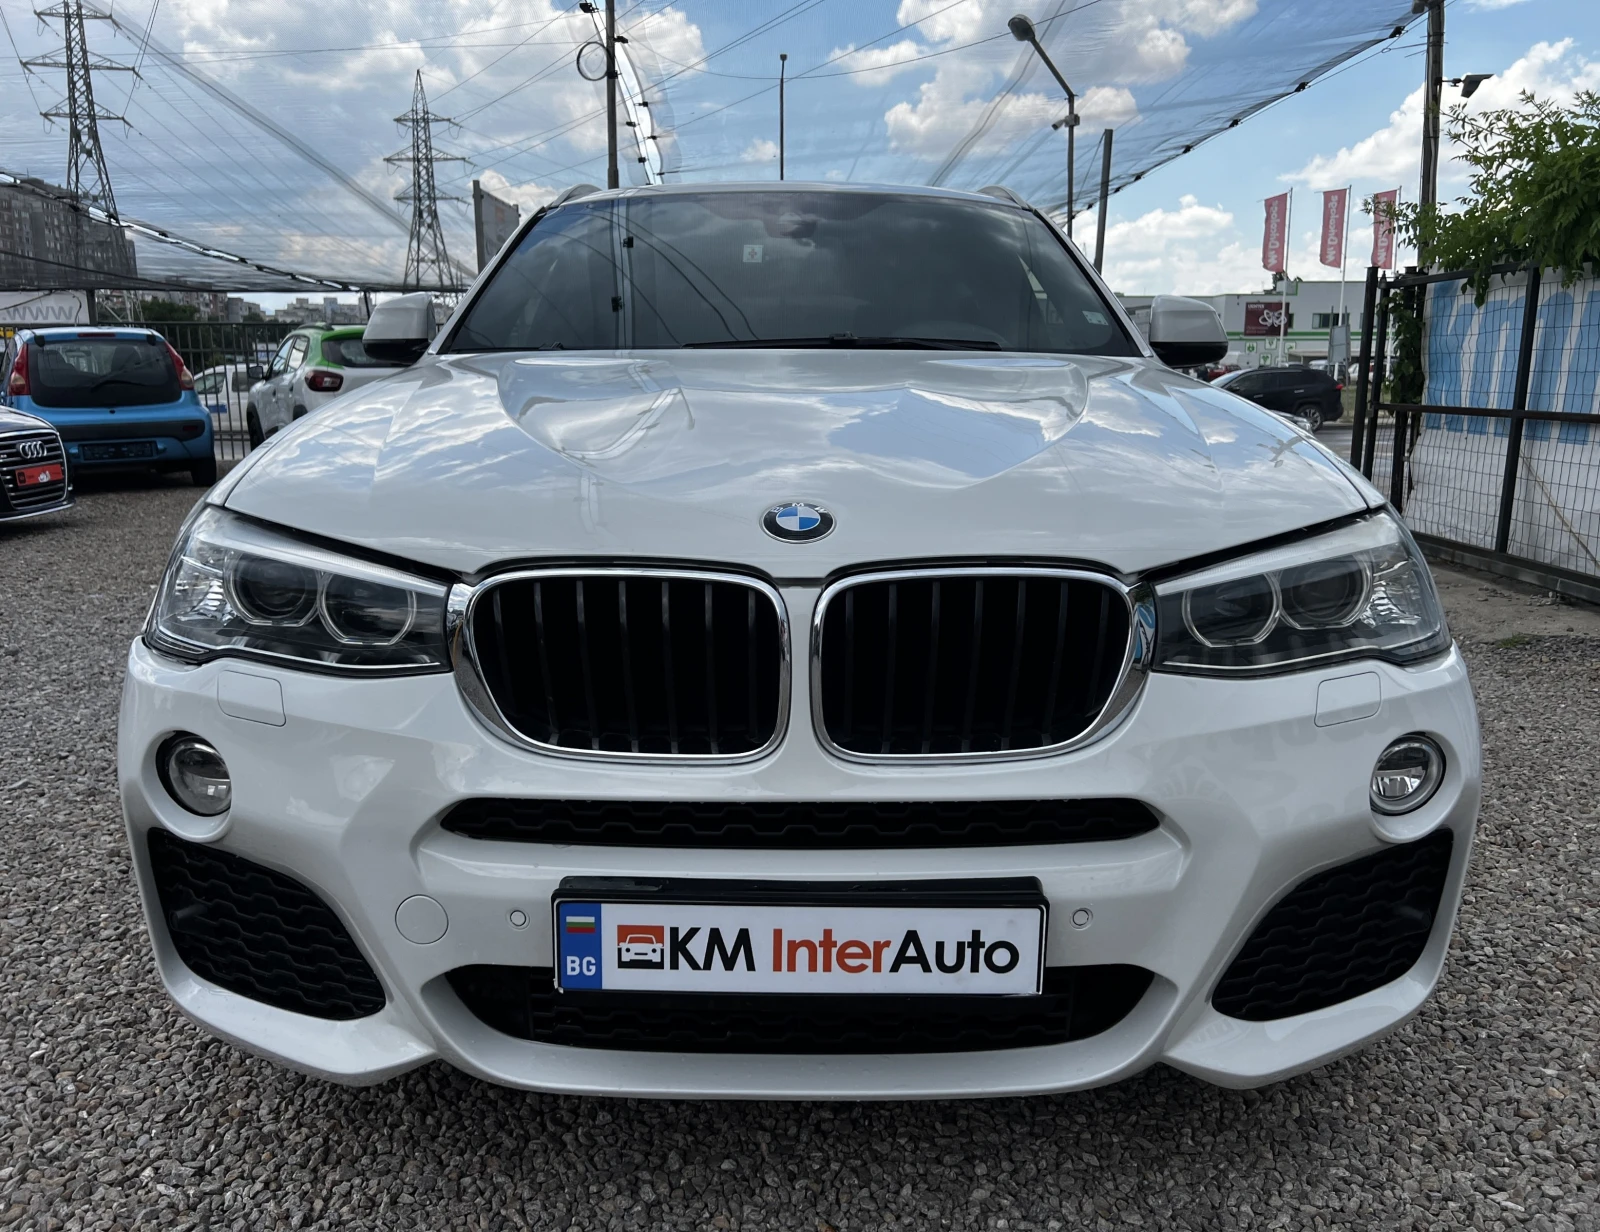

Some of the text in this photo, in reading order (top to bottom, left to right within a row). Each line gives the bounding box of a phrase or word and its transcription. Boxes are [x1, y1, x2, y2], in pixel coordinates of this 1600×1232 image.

[566, 956, 596, 976] BG
[669, 927, 1020, 975] KM InterAuto
